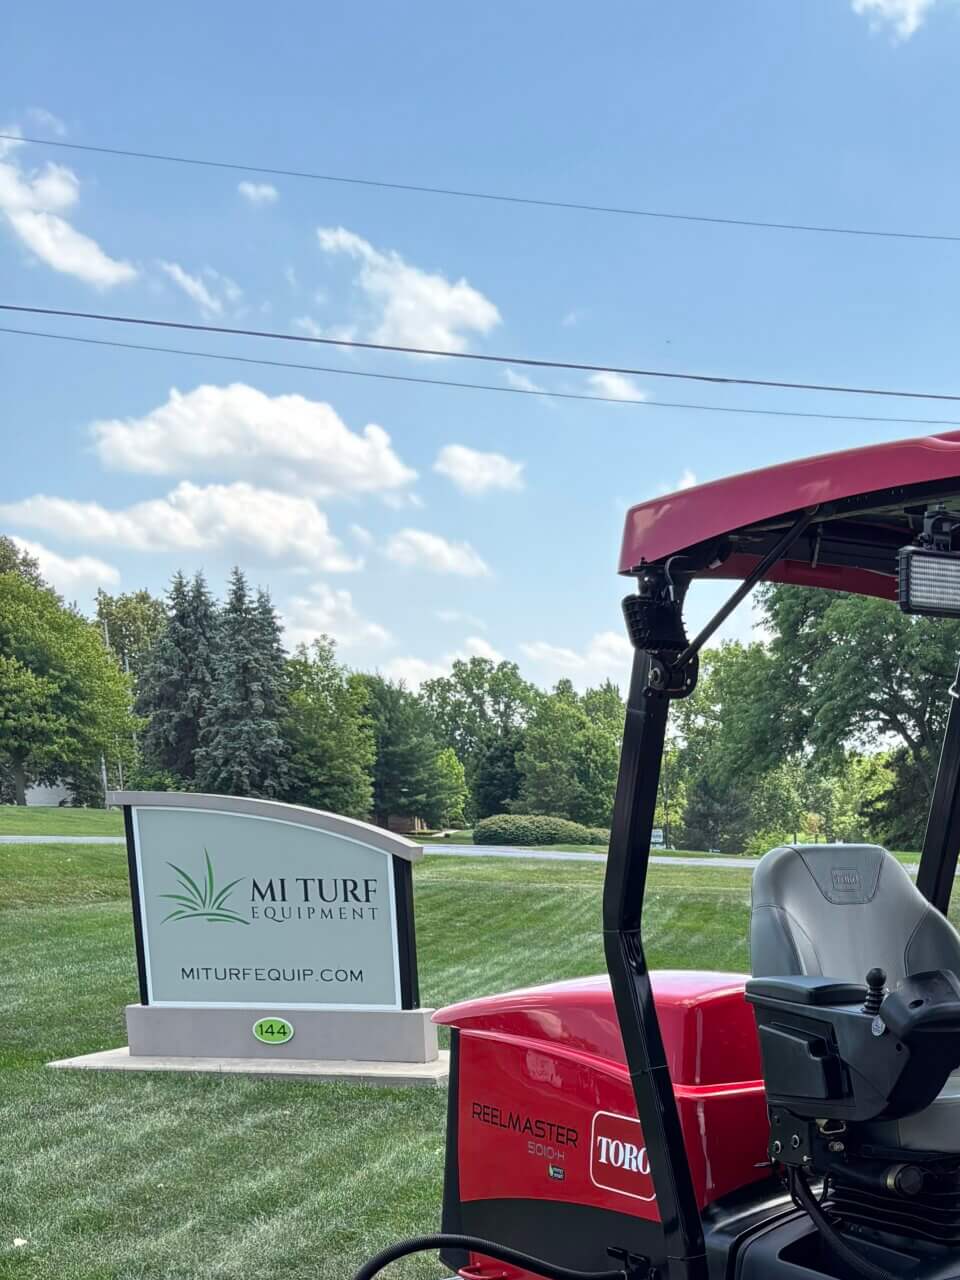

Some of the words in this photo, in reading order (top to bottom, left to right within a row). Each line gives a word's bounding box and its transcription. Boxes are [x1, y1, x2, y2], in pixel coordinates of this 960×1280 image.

[251, 878, 287, 903] MI
[295, 878, 378, 903] TURF
[251, 906, 378, 923] EQUIPMENT
[180, 967, 364, 983] MITURFEQUIP.COM
[257, 1023, 288, 1037] 144
[472, 1102, 578, 1147] REELMASTER
